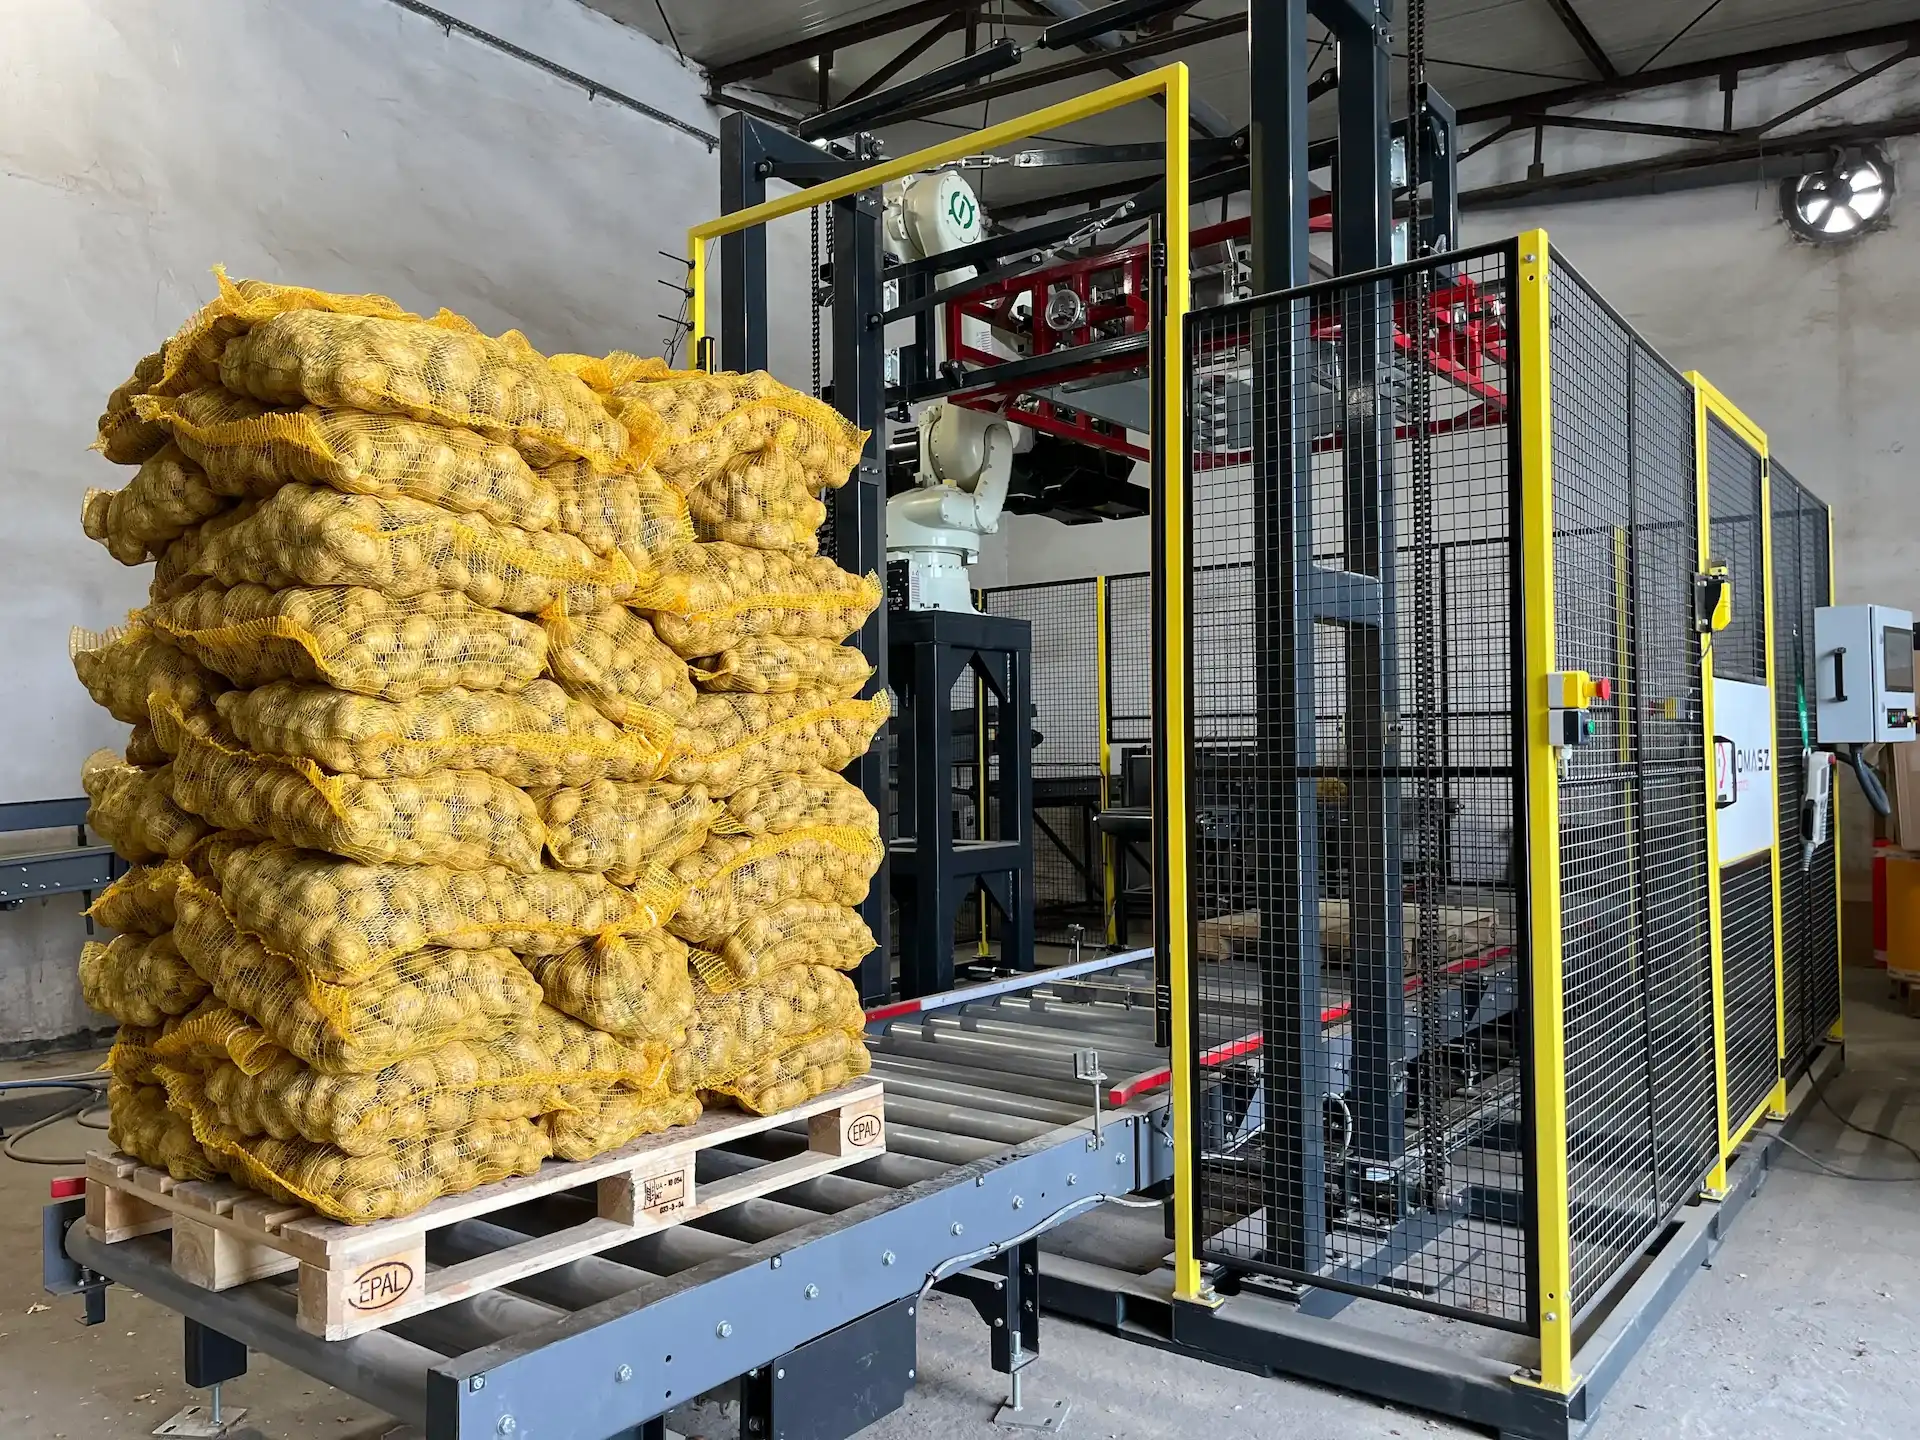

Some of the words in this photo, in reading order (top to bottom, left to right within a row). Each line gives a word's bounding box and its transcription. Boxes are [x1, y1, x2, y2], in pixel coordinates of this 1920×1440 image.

[1735, 749, 1770, 773] OMASZ
[853, 1120, 876, 1142] EPAL
[359, 1270, 404, 1304] EPAL
